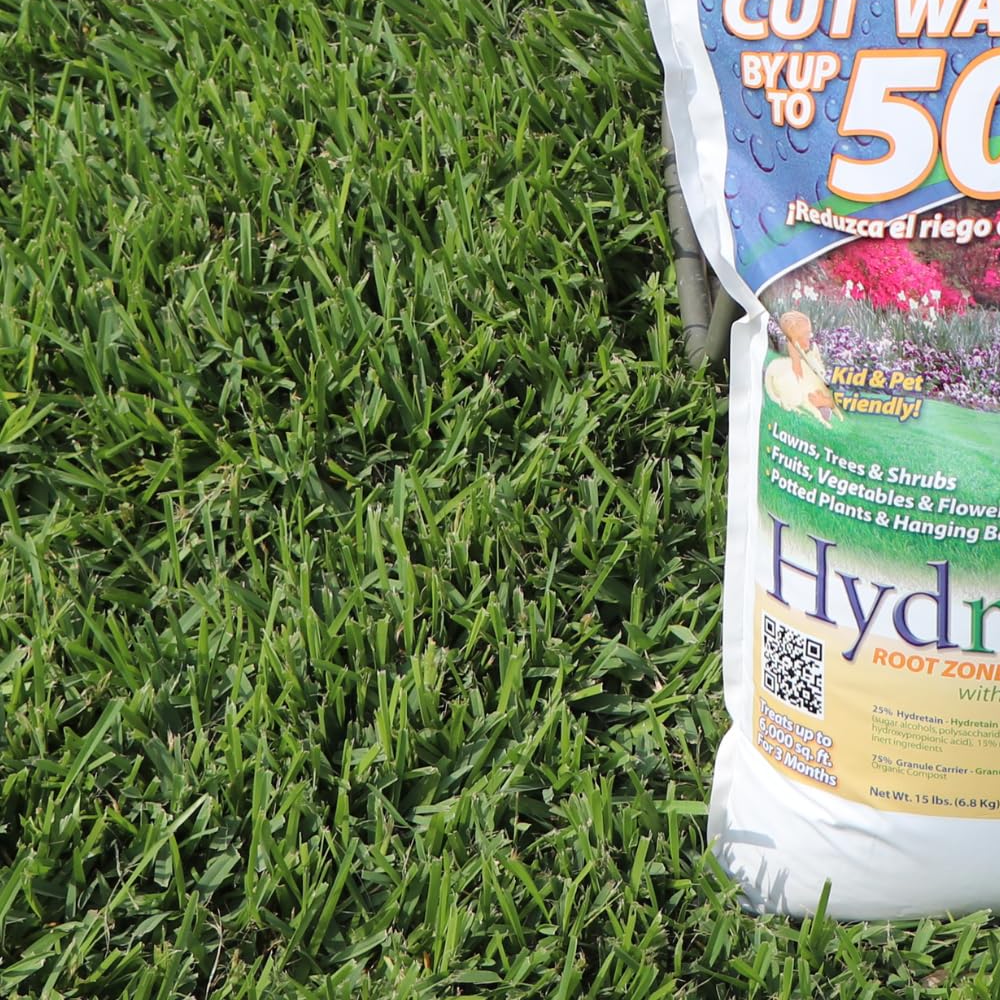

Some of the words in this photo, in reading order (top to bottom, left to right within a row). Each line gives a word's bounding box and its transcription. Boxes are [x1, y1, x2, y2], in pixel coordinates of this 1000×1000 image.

[741, 51, 788, 89] BY
[787, 52, 841, 91] UP
[766, 90, 816, 129] TO
[889, 213, 917, 239] el
[919, 212, 992, 244] riego
[831, 366, 868, 387] Kid
[869, 369, 887, 389] &
[889, 371, 924, 392] Pet
[833, 391, 922, 421] Friendly!
[772, 422, 820, 459] Lawns,
[824, 446, 865, 476] Trees
[868, 463, 884, 481] &
[887, 466, 957, 490] Shrubs
[771, 445, 813, 482] Fruits,
[818, 467, 915, 509] Vegetables
[918, 495, 934, 512] &
[771, 468, 818, 504] Potted
[818, 491, 872, 522] Plants
[875, 511, 890, 528] &
[893, 514, 980, 544] Hanging
[872, 647, 939, 675] ROOT
[759, 698, 794, 732] Treats
[795, 724, 815, 743] up
[815, 731, 833, 748] to
[871, 715, 898, 729] (sugar
[896, 709, 944, 725] Hydretain
[950, 717, 999, 729] Hydretain
[872, 723, 948, 745] hydroxypropionic
[978, 739, 998, 748] 15%
[893, 738, 943, 753] ingredients
[757, 732, 774, 754] For
[774, 745, 783, 761] 3
[783, 752, 838, 787] Months
[795, 742, 815, 761] sq.
[816, 749, 834, 768] ft.
[896, 758, 934, 771] Granule
[935, 764, 968, 775] Carrier
[871, 761, 905, 775] Organic
[906, 767, 947, 780] Compost
[869, 786, 890, 799] Net
[892, 790, 912, 803] Wt.
[915, 794, 929, 804] 15
[931, 795, 953, 807] lbs.
[954, 798, 977, 808] (6.8
[980, 799, 1000, 810] Kg)
